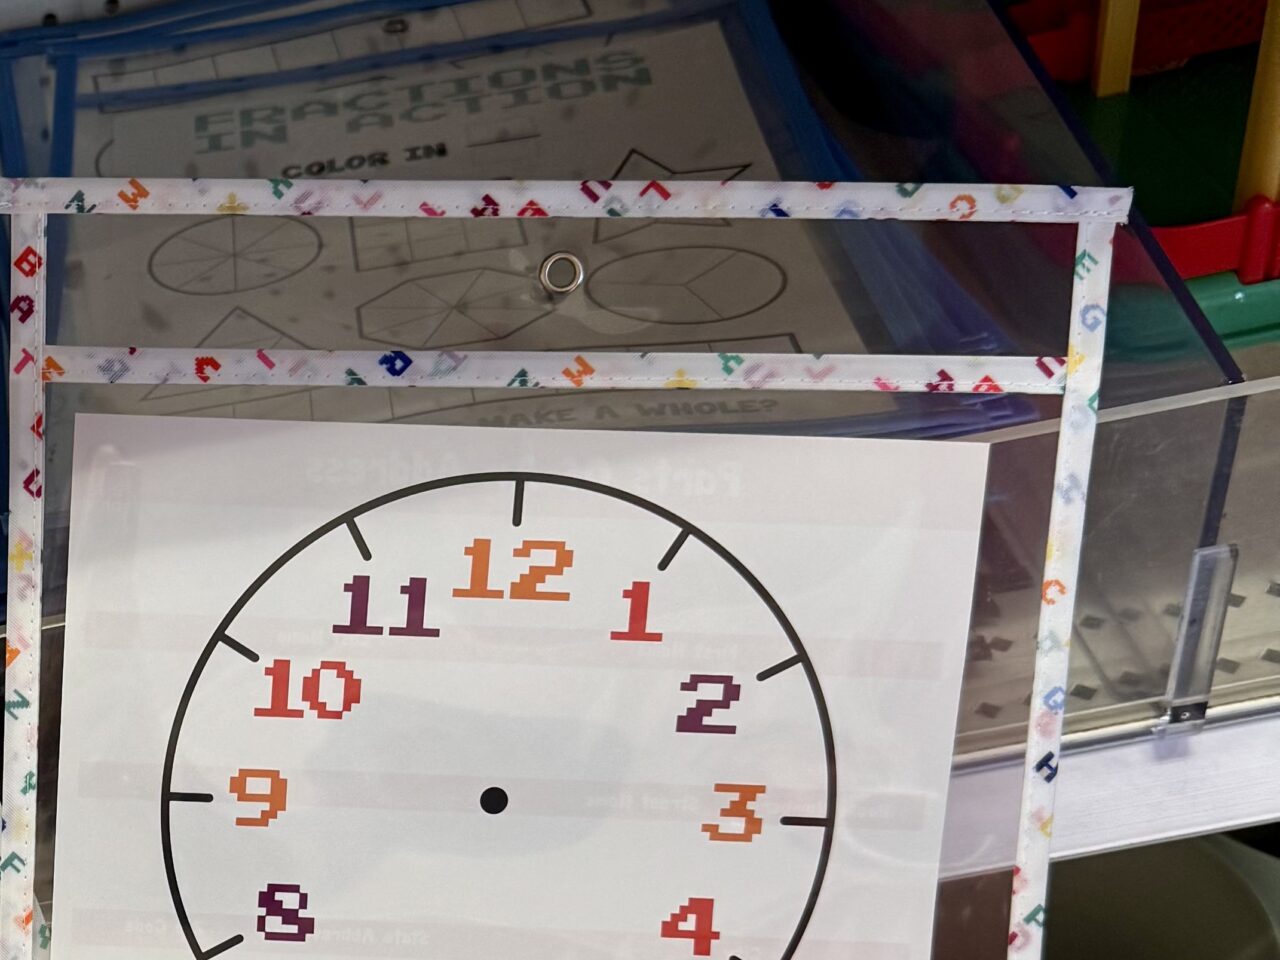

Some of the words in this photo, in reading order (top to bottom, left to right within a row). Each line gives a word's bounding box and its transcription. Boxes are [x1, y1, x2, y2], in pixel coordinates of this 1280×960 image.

[193, 50, 646, 133] FRACTIONS
[195, 124, 288, 154] IN
[346, 67, 653, 134] ACTION
[281, 152, 390, 178] COLOR
[405, 142, 448, 162] IN
[452, 538, 574, 601] 12
[332, 575, 440, 637] 11
[610, 581, 663, 641] 1
[253, 659, 362, 719] 10
[676, 674, 741, 733] 2
[229, 768, 288, 826] 9
[702, 783, 766, 842] 3
[257, 883, 314, 941] 8
[661, 898, 720, 955] 4
